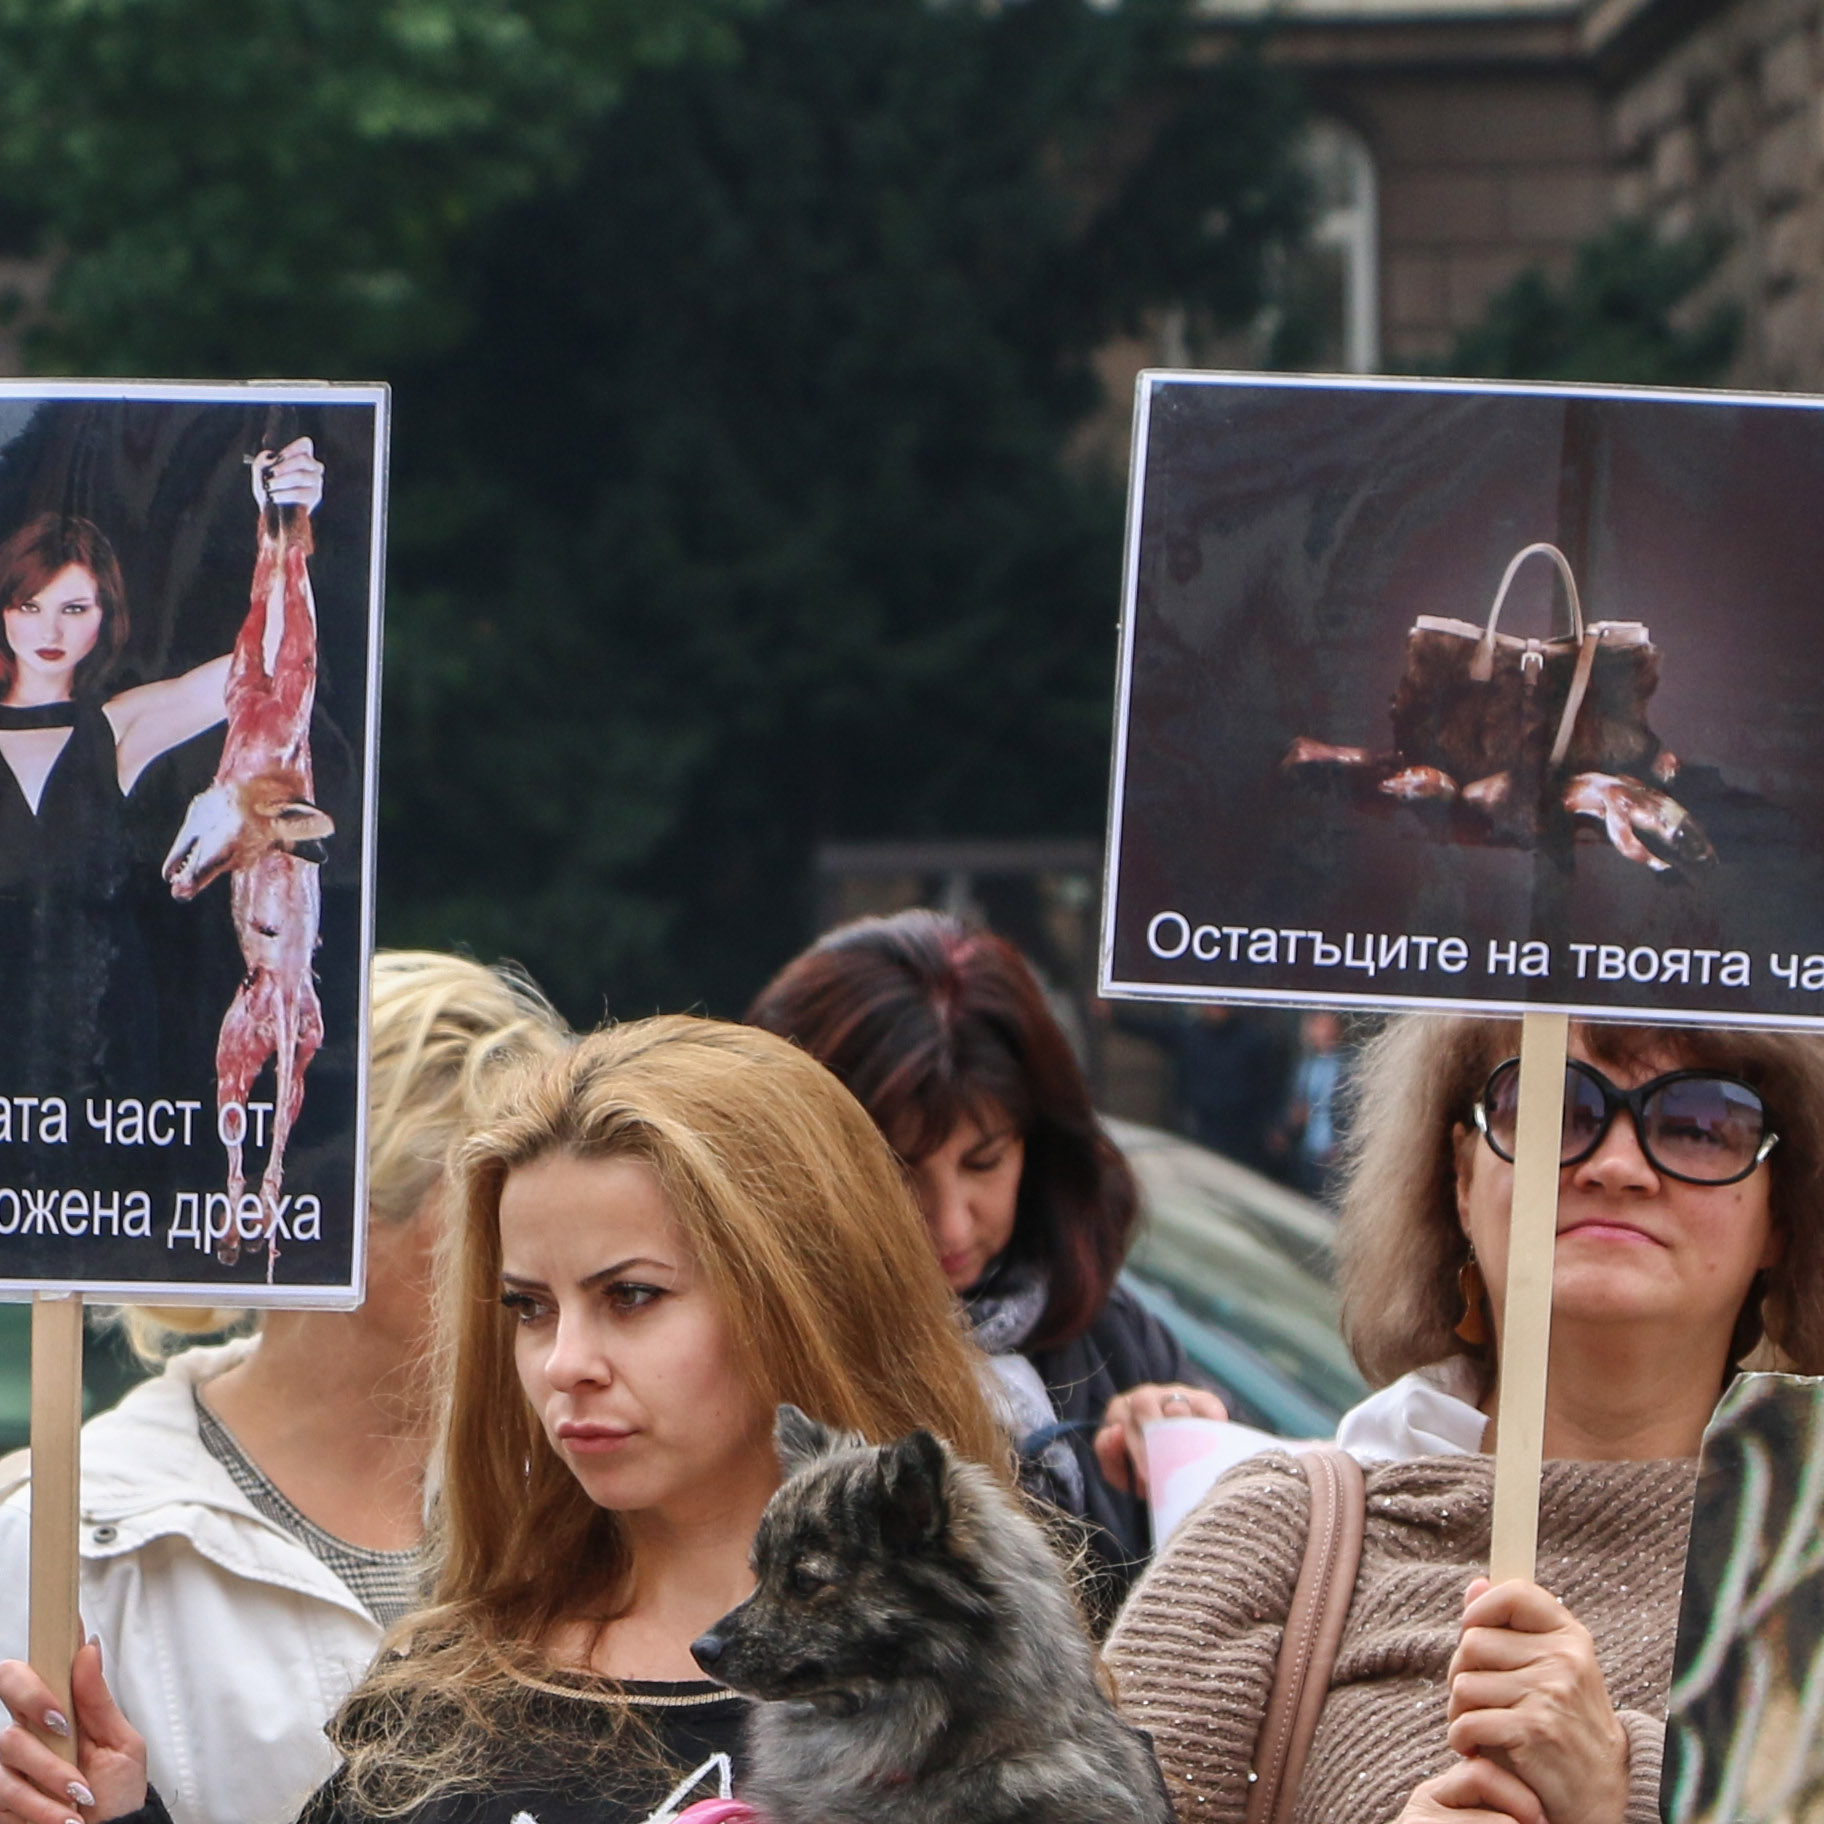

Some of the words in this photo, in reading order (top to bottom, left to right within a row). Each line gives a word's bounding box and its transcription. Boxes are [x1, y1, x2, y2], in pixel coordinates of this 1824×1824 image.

[1146, 910, 1469, 977] Остатъците
[1487, 939, 1550, 976] на
[1569, 943, 1751, 986] твоята
[86, 1098, 201, 1147] част
[217, 1101, 274, 1148] от
[166, 1190, 321, 1253] дреха
